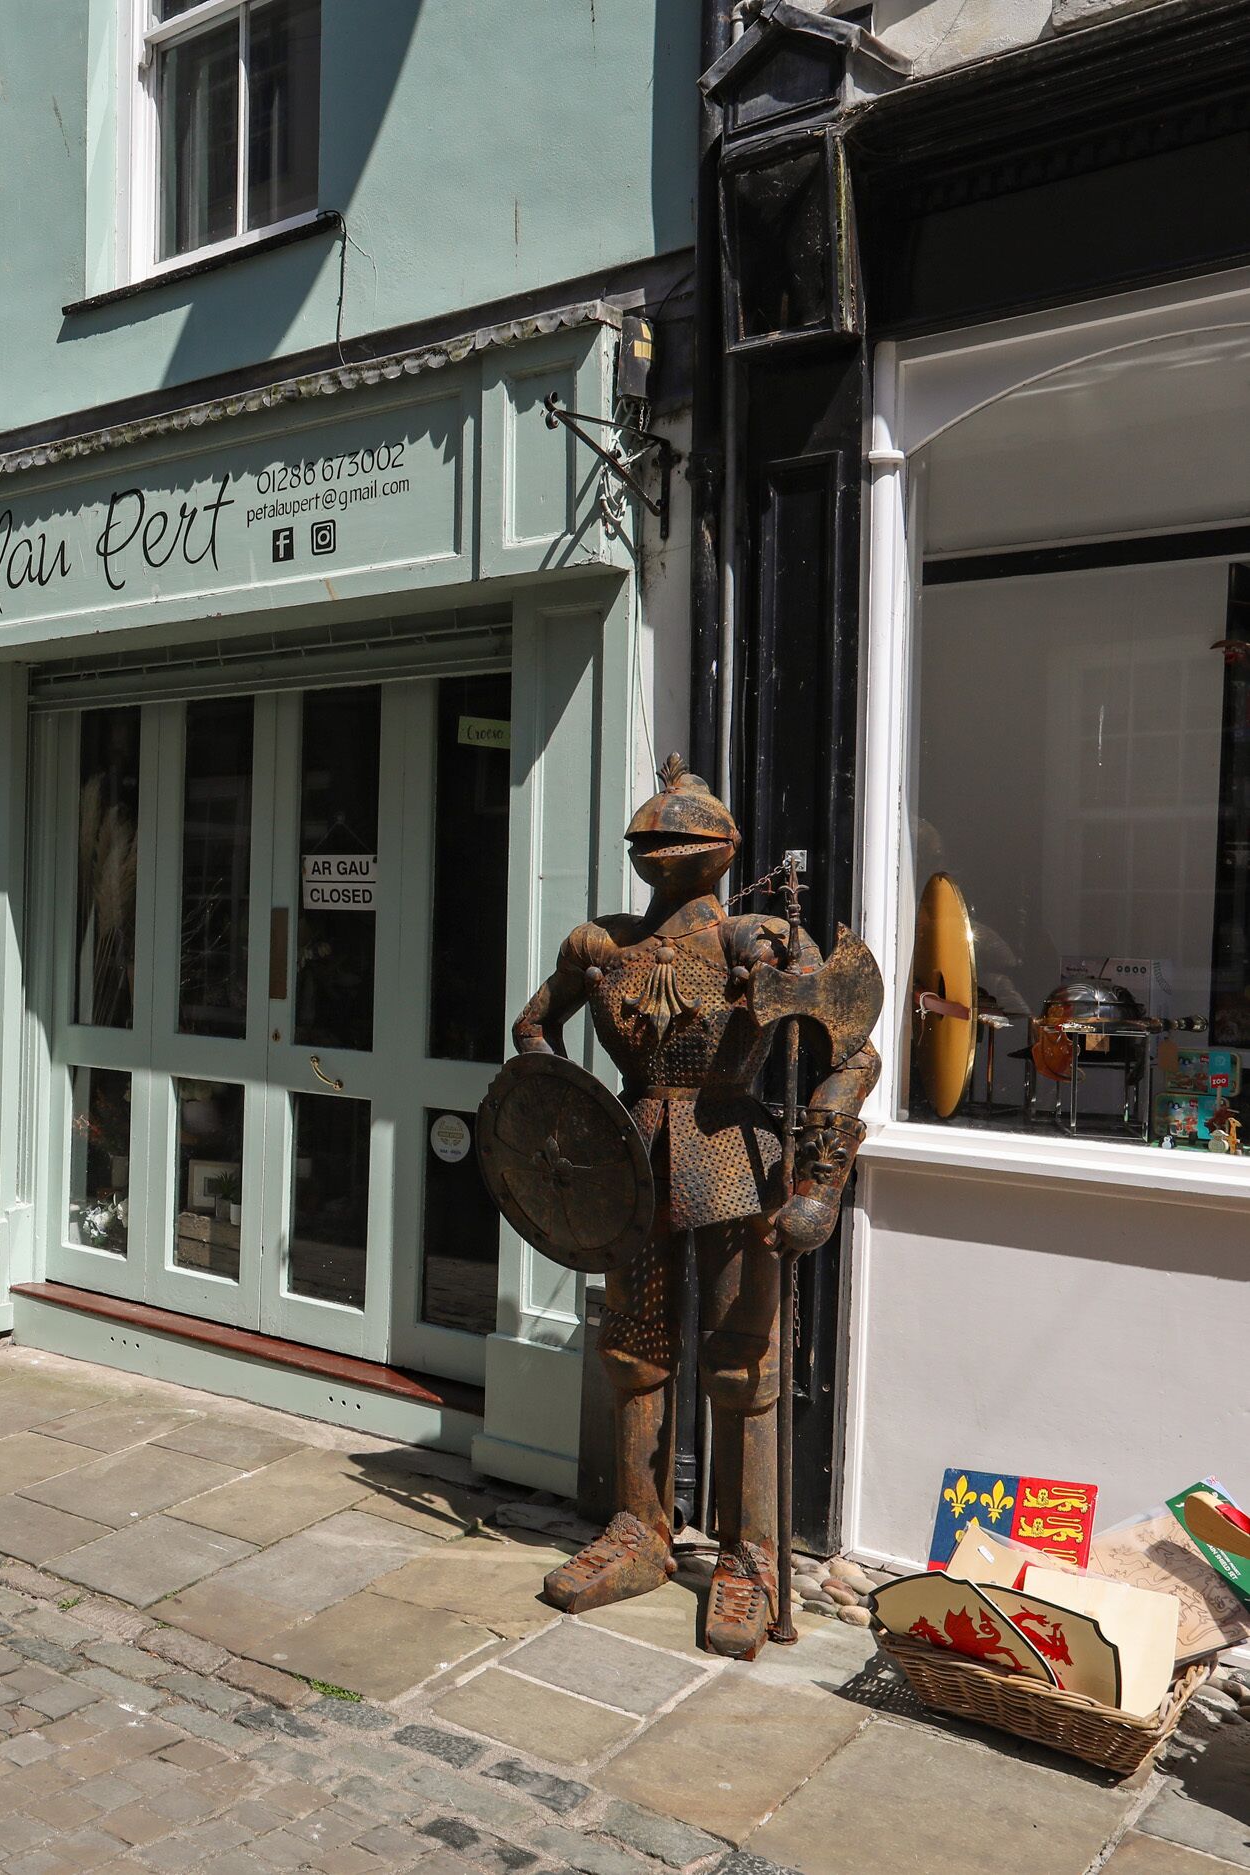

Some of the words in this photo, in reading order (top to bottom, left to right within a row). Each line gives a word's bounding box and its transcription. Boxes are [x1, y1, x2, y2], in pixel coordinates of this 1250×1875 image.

[256, 462, 316, 494] 01286
[321, 442, 405, 482] 673002
[246, 478, 410, 528] petalaupert@gmail.com
[96, 472, 235, 591] Pert
[311, 861, 332, 875] AR
[337, 861, 369, 876] GAU
[310, 888, 372, 904] CLOSED
[1215, 1554, 1231, 1571] SHIELD
[1227, 1571, 1238, 1580] SET
